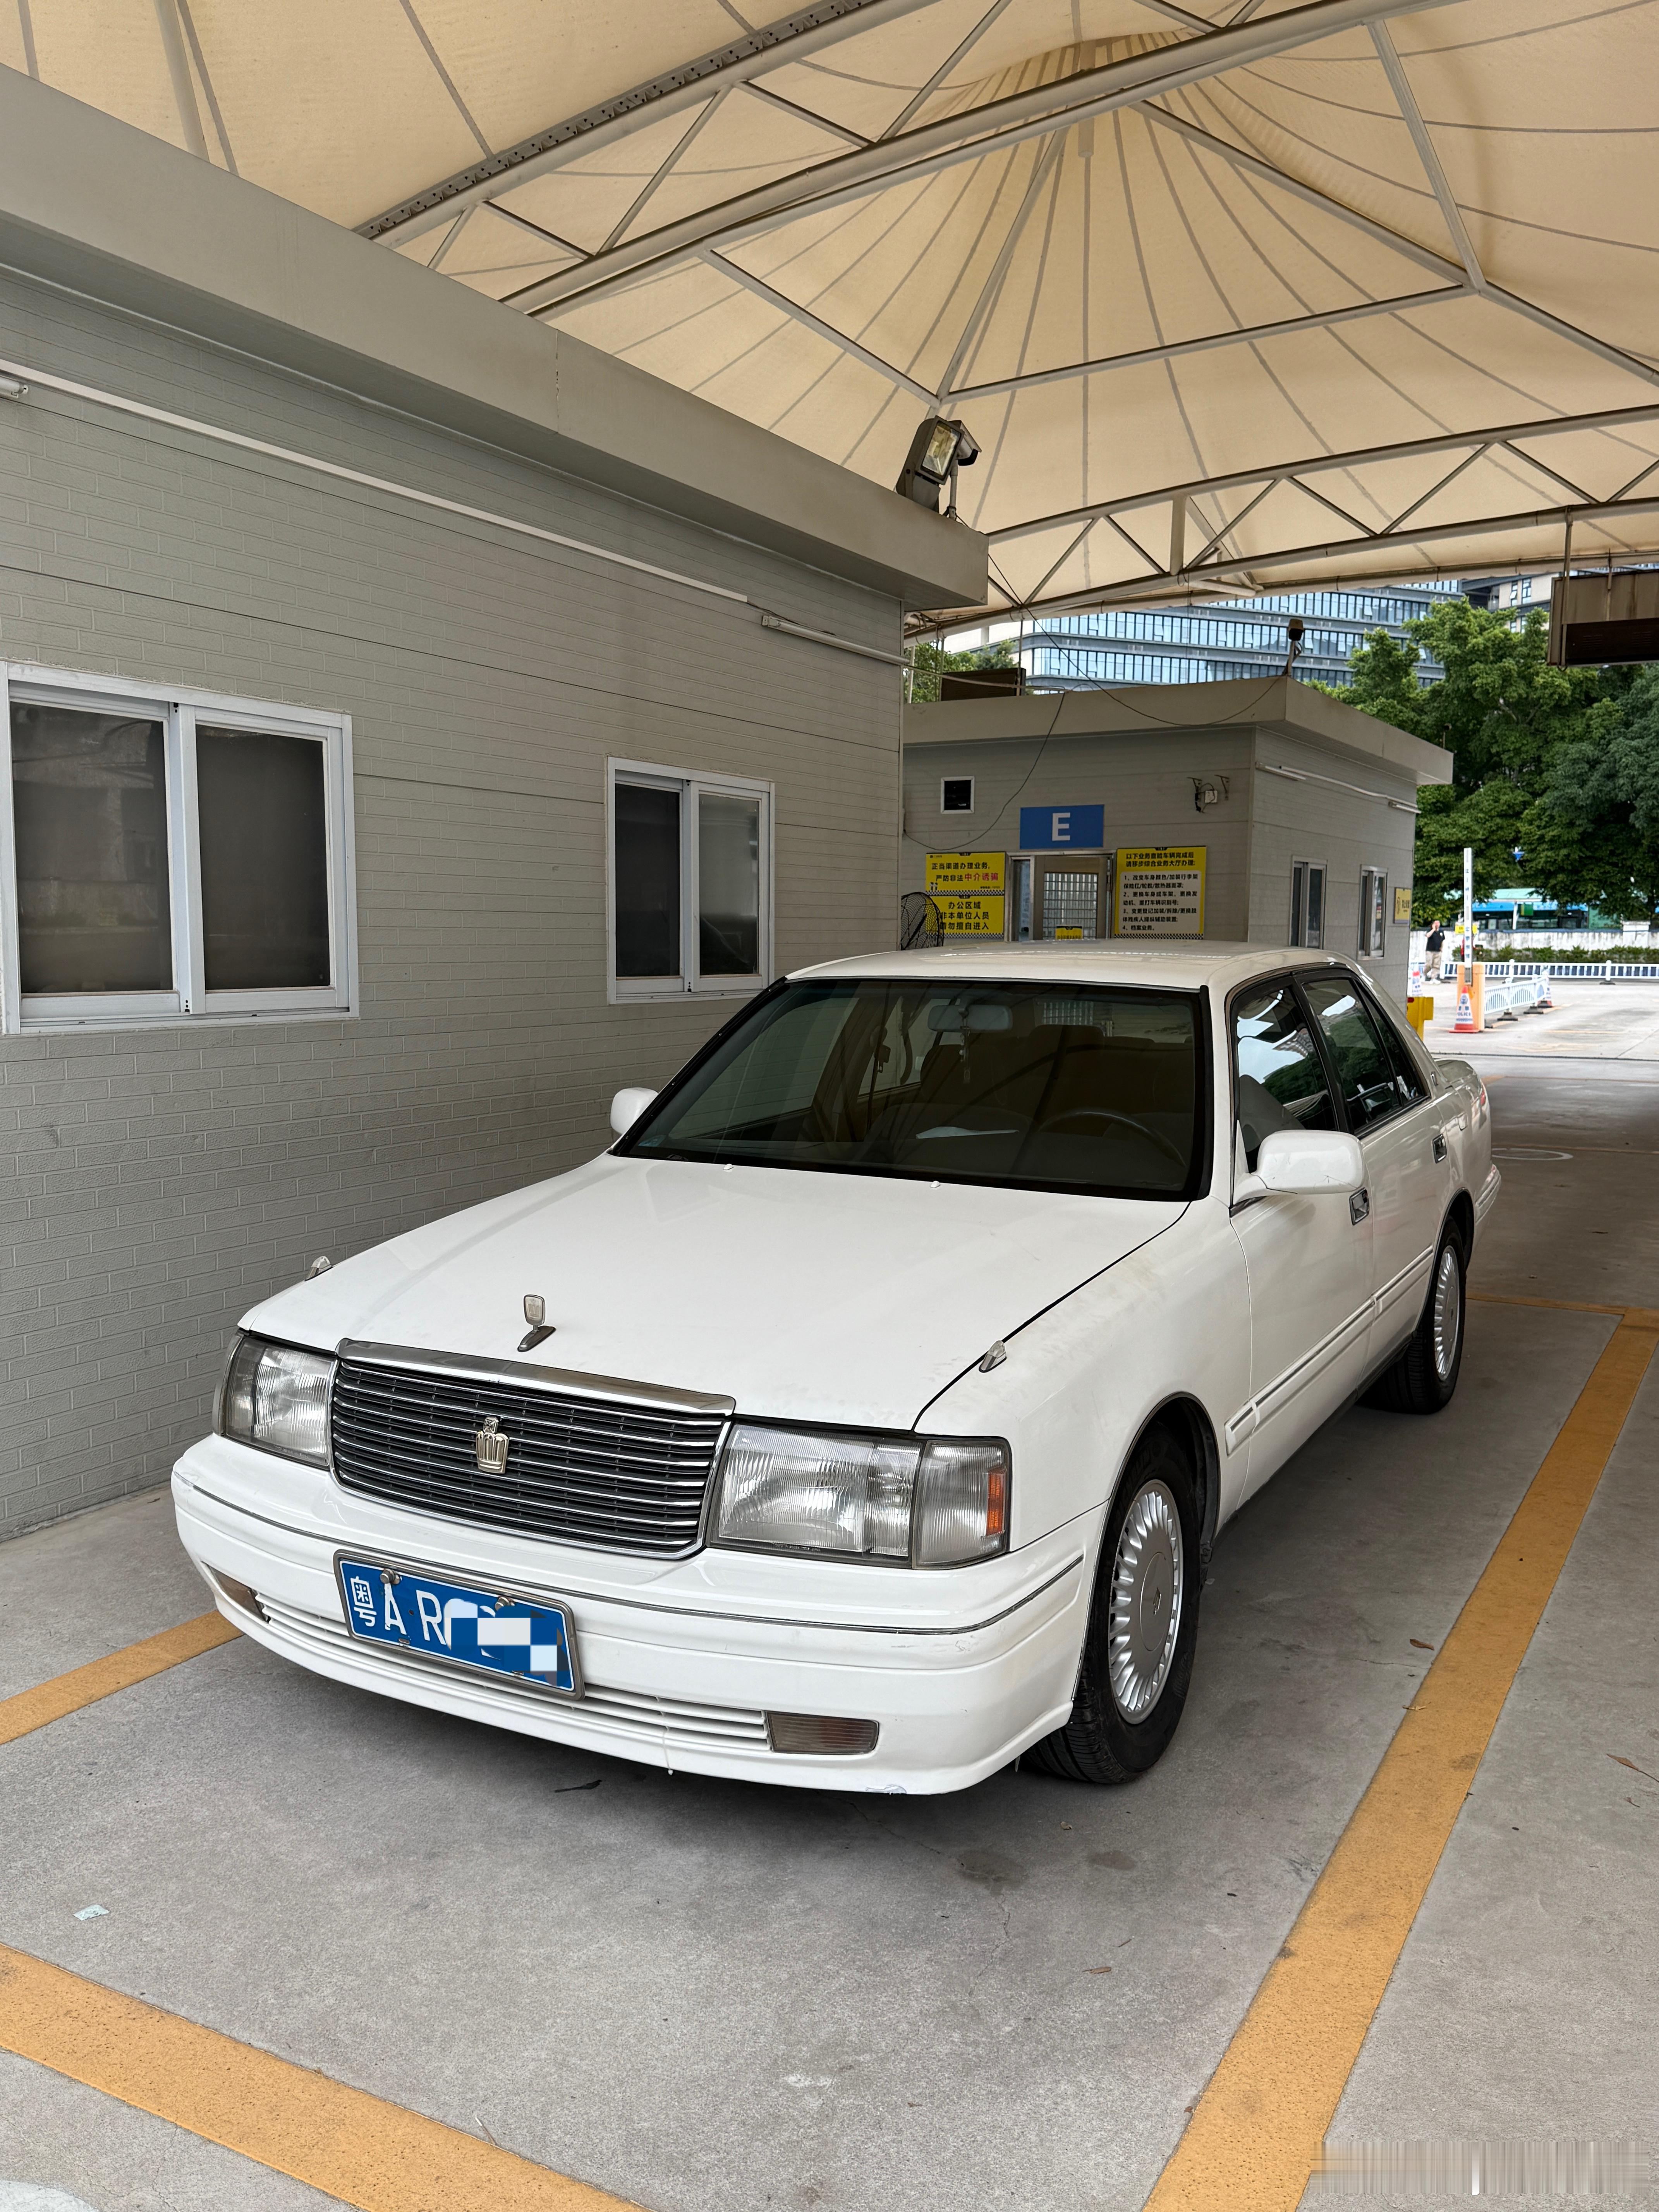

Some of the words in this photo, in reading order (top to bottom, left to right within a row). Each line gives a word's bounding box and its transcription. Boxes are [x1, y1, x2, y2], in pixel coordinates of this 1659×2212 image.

[1052, 812, 1070, 841] E
[936, 872, 998, 882] 严防非法中介诱骗
